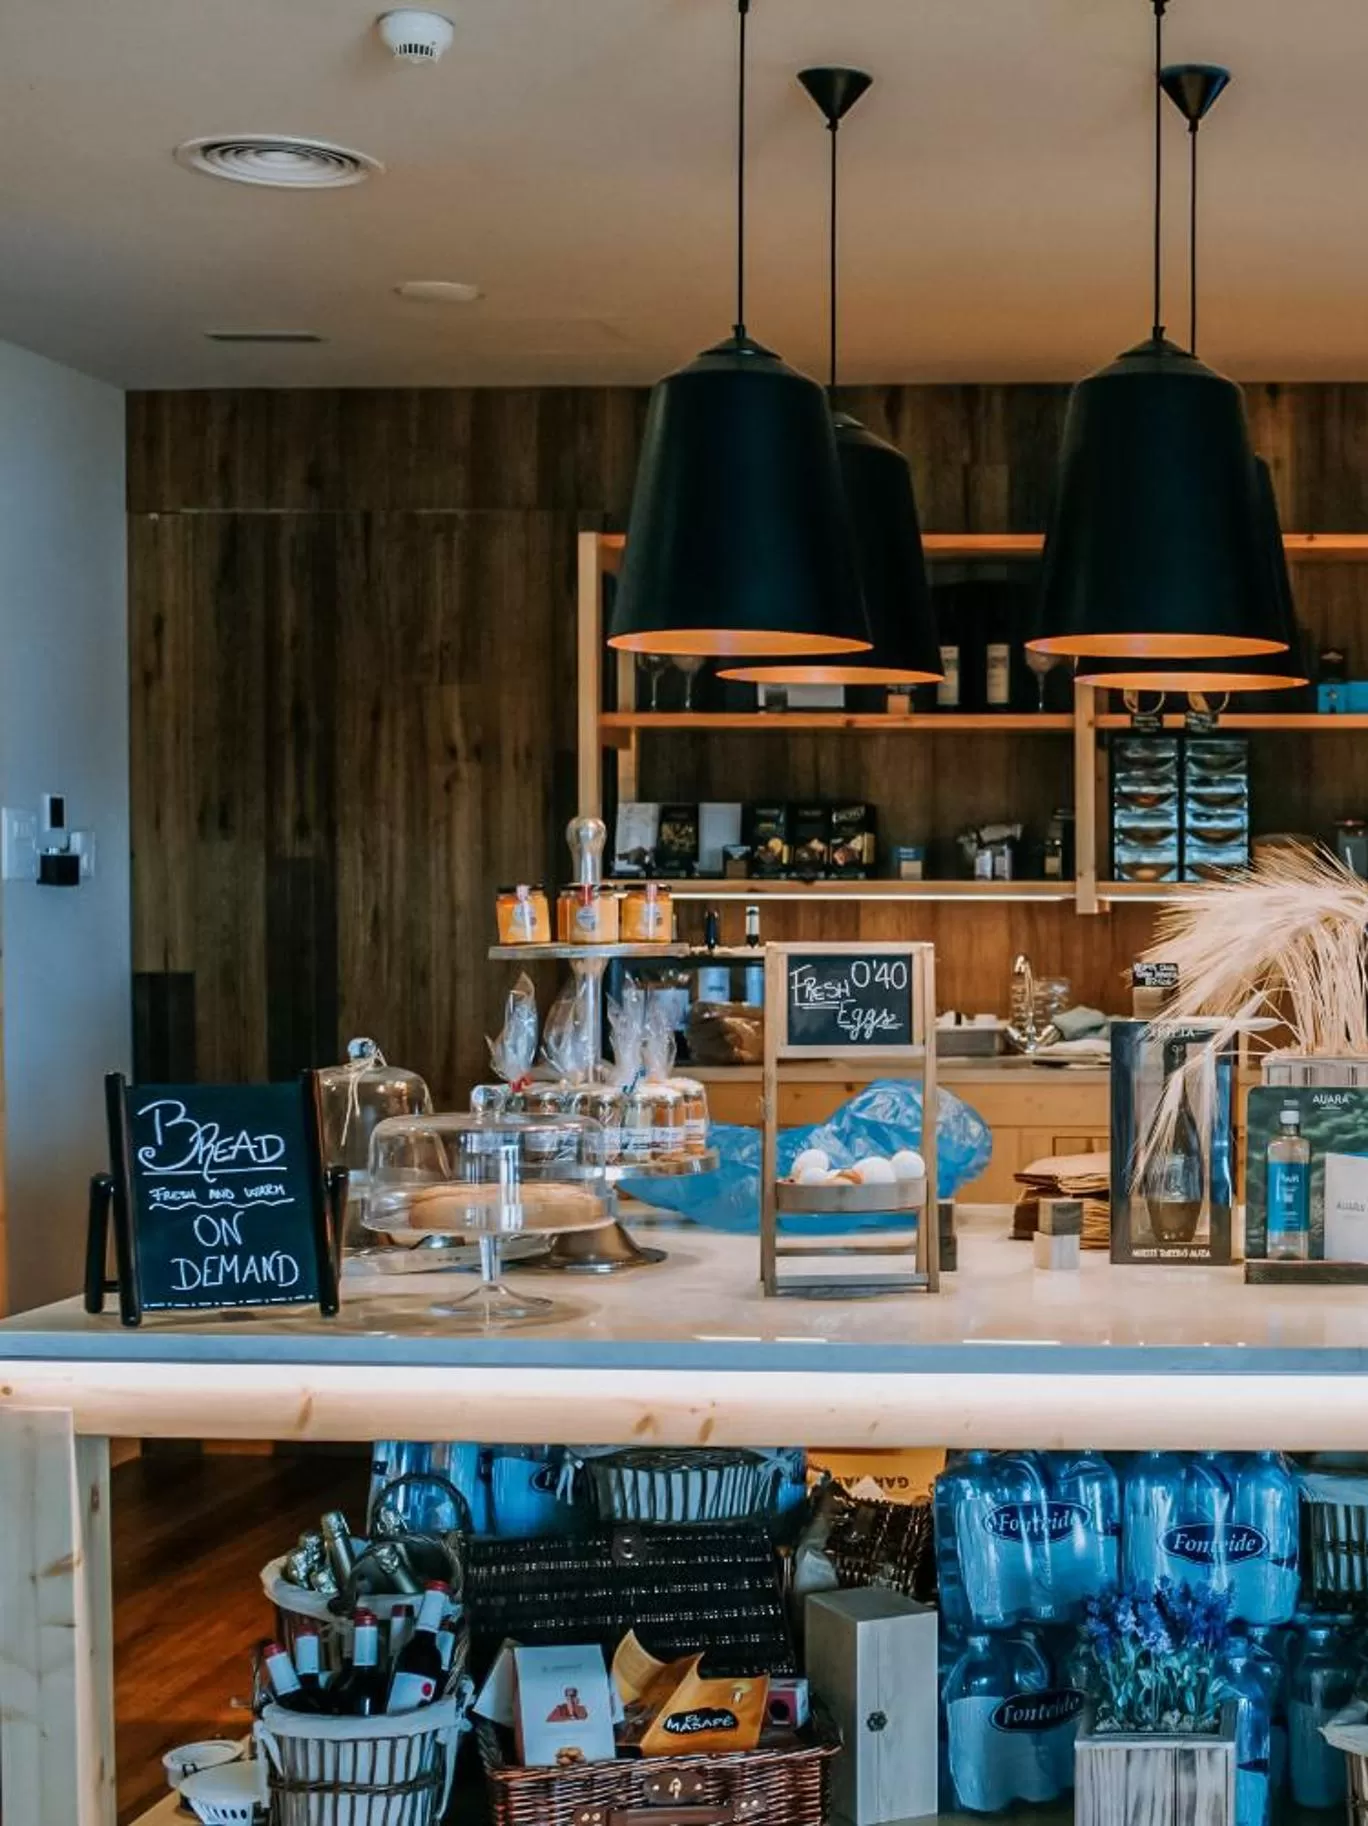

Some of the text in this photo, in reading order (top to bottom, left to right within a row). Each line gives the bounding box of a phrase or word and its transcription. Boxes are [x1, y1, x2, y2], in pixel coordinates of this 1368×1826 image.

[789, 964, 850, 1006] FRESH
[836, 999, 898, 1040] Eggs
[1312, 1093, 1350, 1105] AUARA
[137, 1099, 286, 1183] BREAD
[149, 1184, 286, 1202] FRESH AND WARM
[193, 1211, 245, 1247] ON
[170, 1252, 299, 1291] DEMAND
